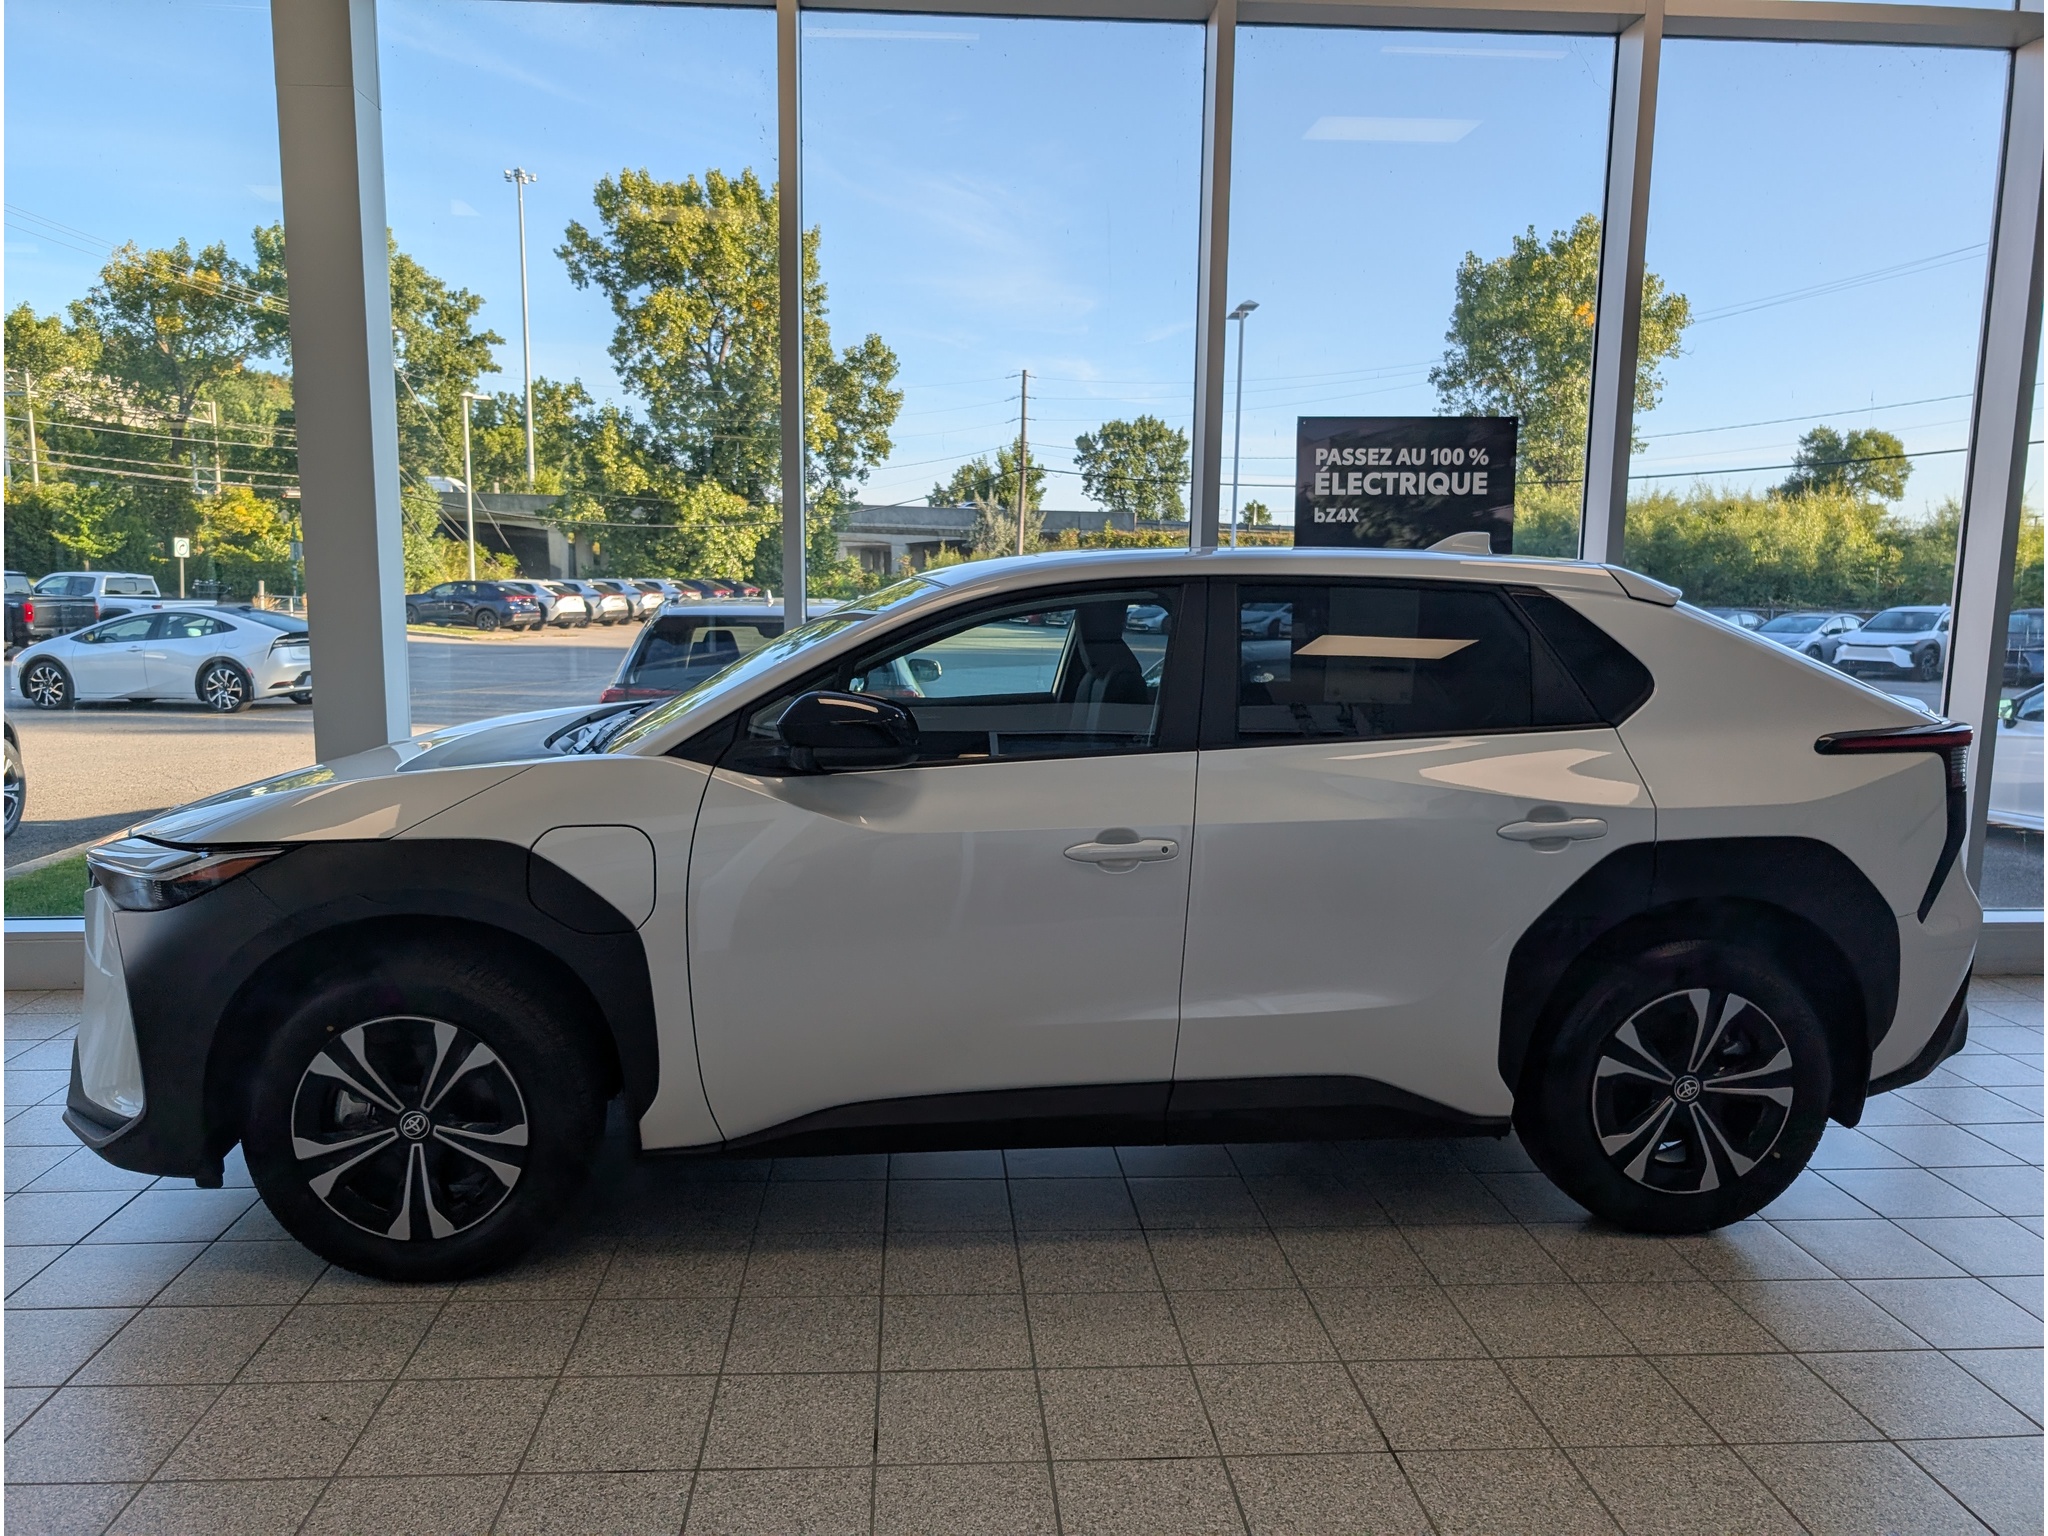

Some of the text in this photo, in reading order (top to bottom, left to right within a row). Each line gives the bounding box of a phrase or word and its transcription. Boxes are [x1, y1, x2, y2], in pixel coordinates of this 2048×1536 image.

[1315, 447, 1489, 466] PASSEZ AU 100 %
[1314, 465, 1488, 496] ÉLECTRIQUE
[1314, 507, 1359, 523] bZ4X
